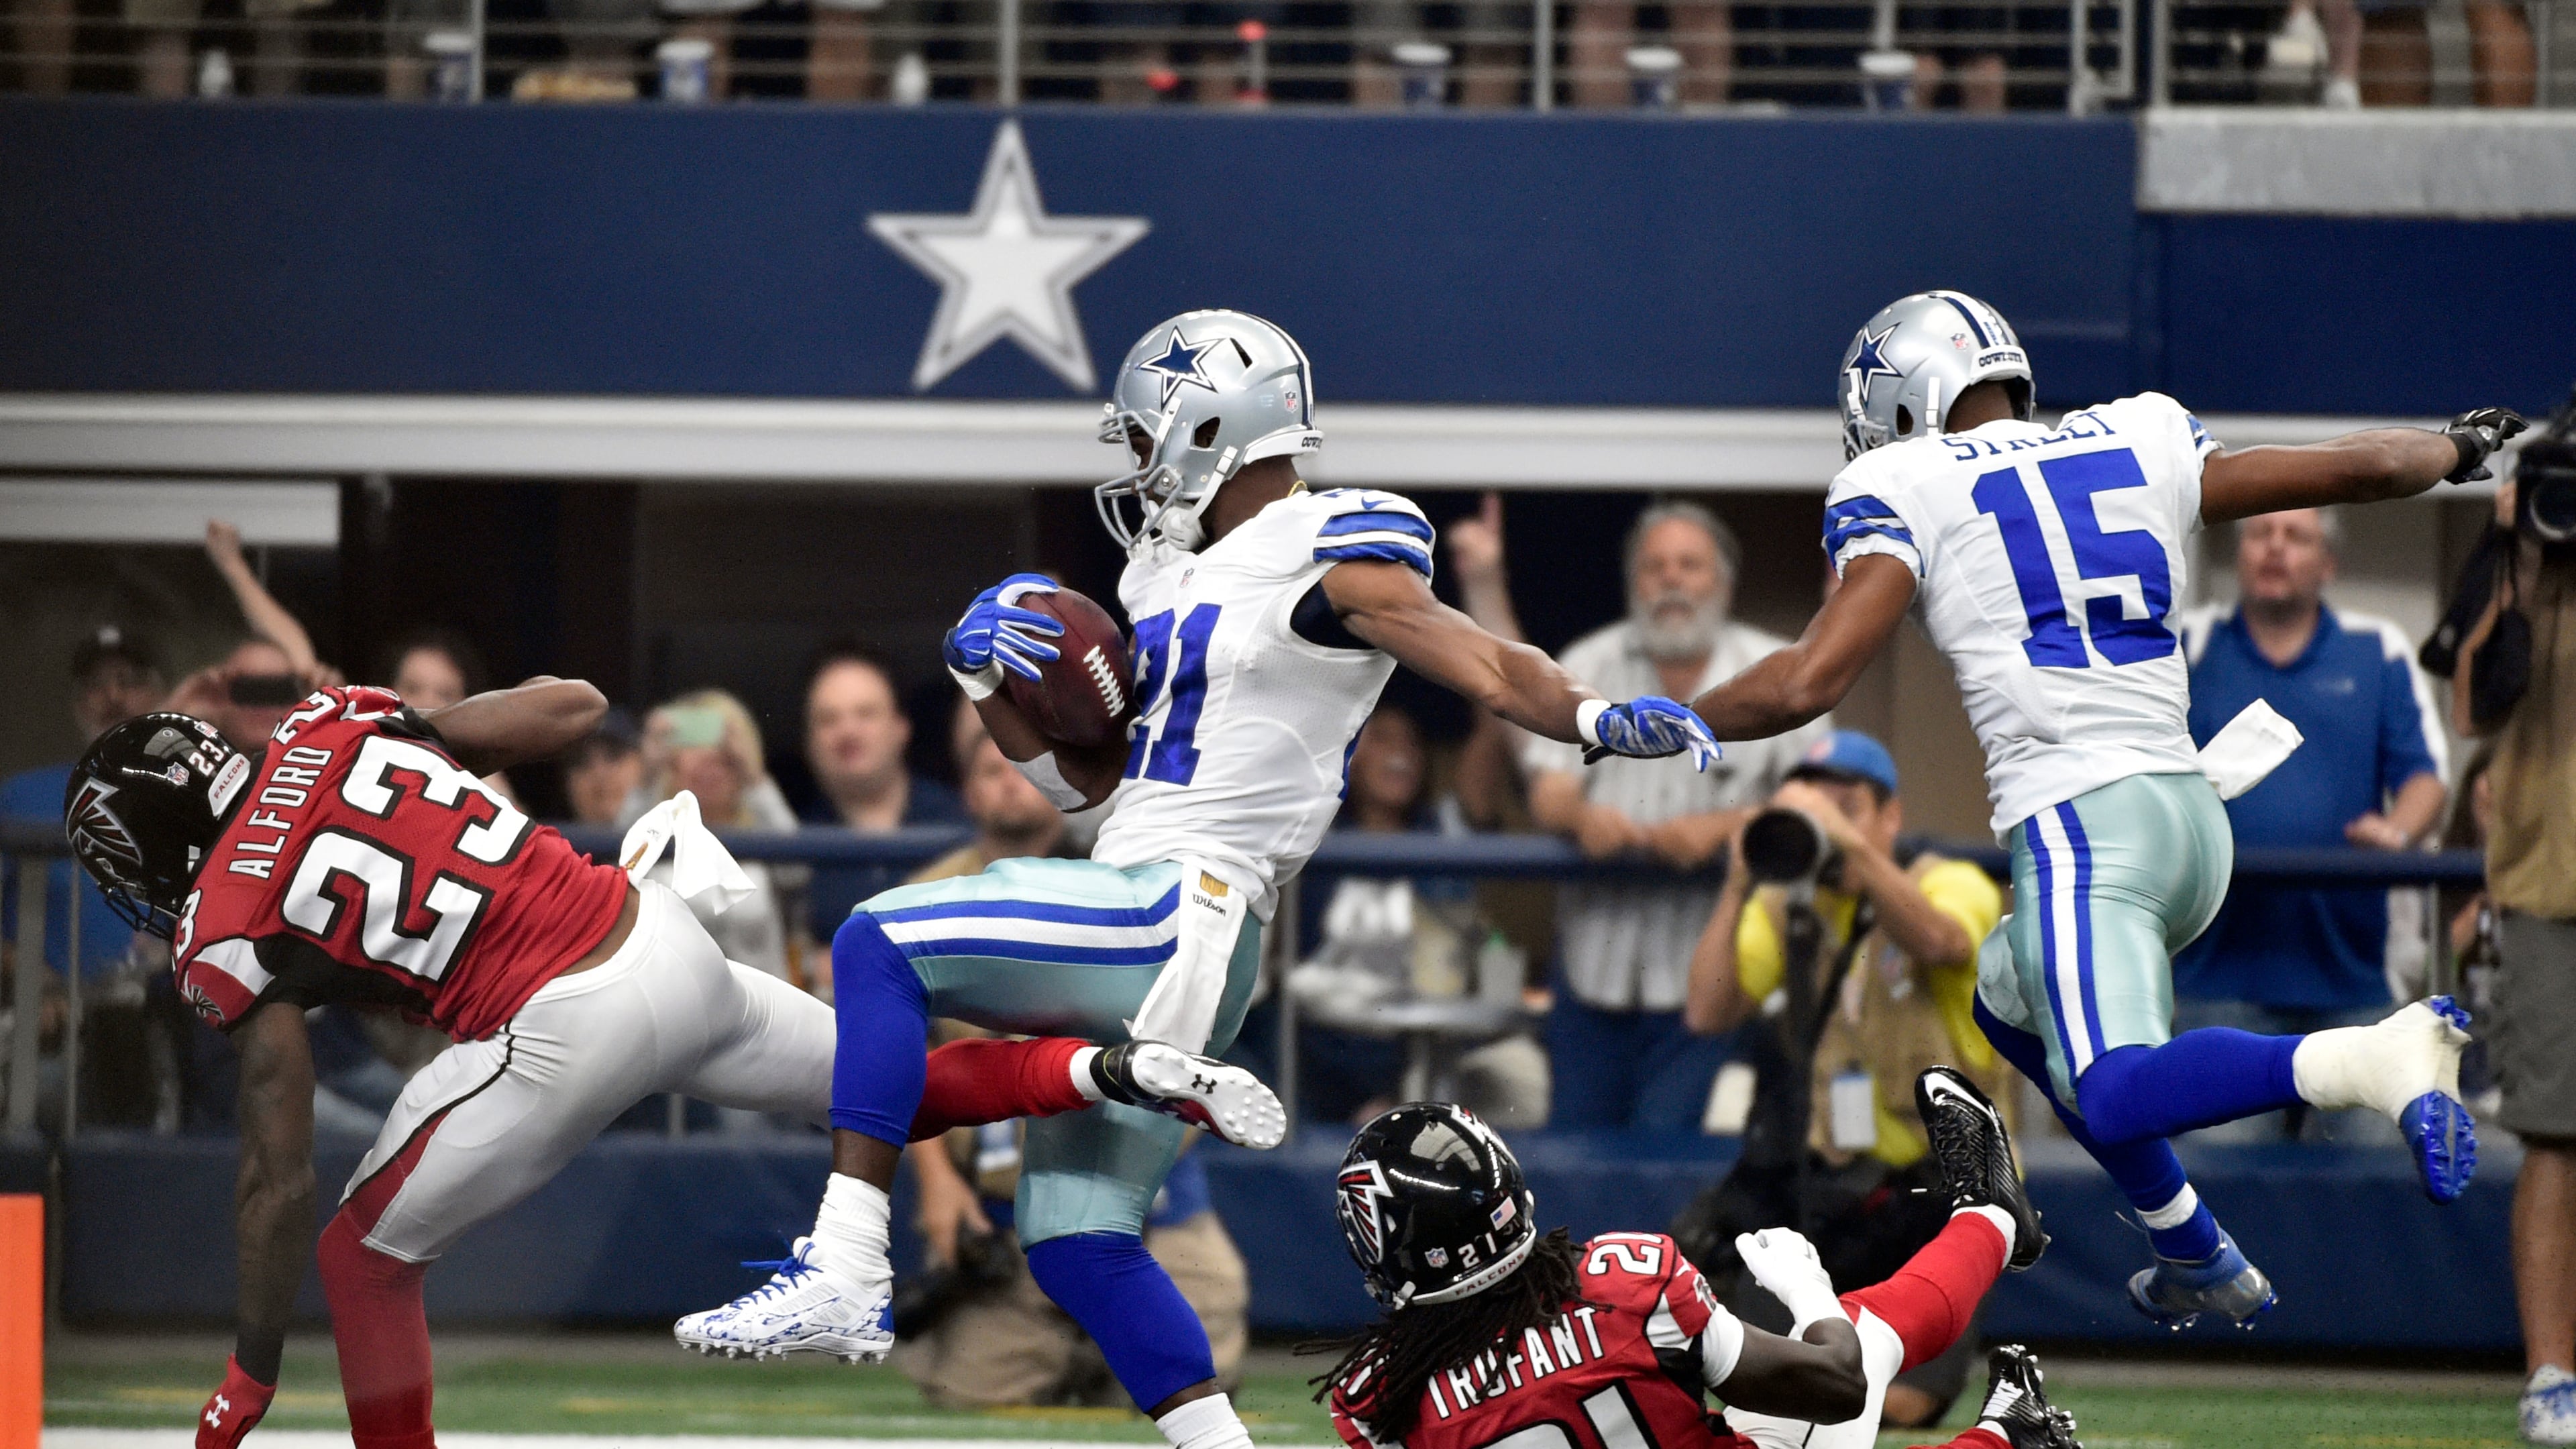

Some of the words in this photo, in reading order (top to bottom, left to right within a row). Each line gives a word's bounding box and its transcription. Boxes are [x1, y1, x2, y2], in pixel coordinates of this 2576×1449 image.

[1972, 447, 2176, 669] 15
[1122, 602, 1222, 786] 21
[188, 739, 225, 777] 23
[213, 758, 246, 800] FALCONS
[228, 746, 333, 879] ALFORD
[281, 734, 531, 983] 23
[1193, 894, 1227, 917] Wilson
[1457, 1232, 1497, 1269] 21
[1587, 1232, 1662, 1275] 21
[1455, 1252, 1525, 1295] FALCONS
